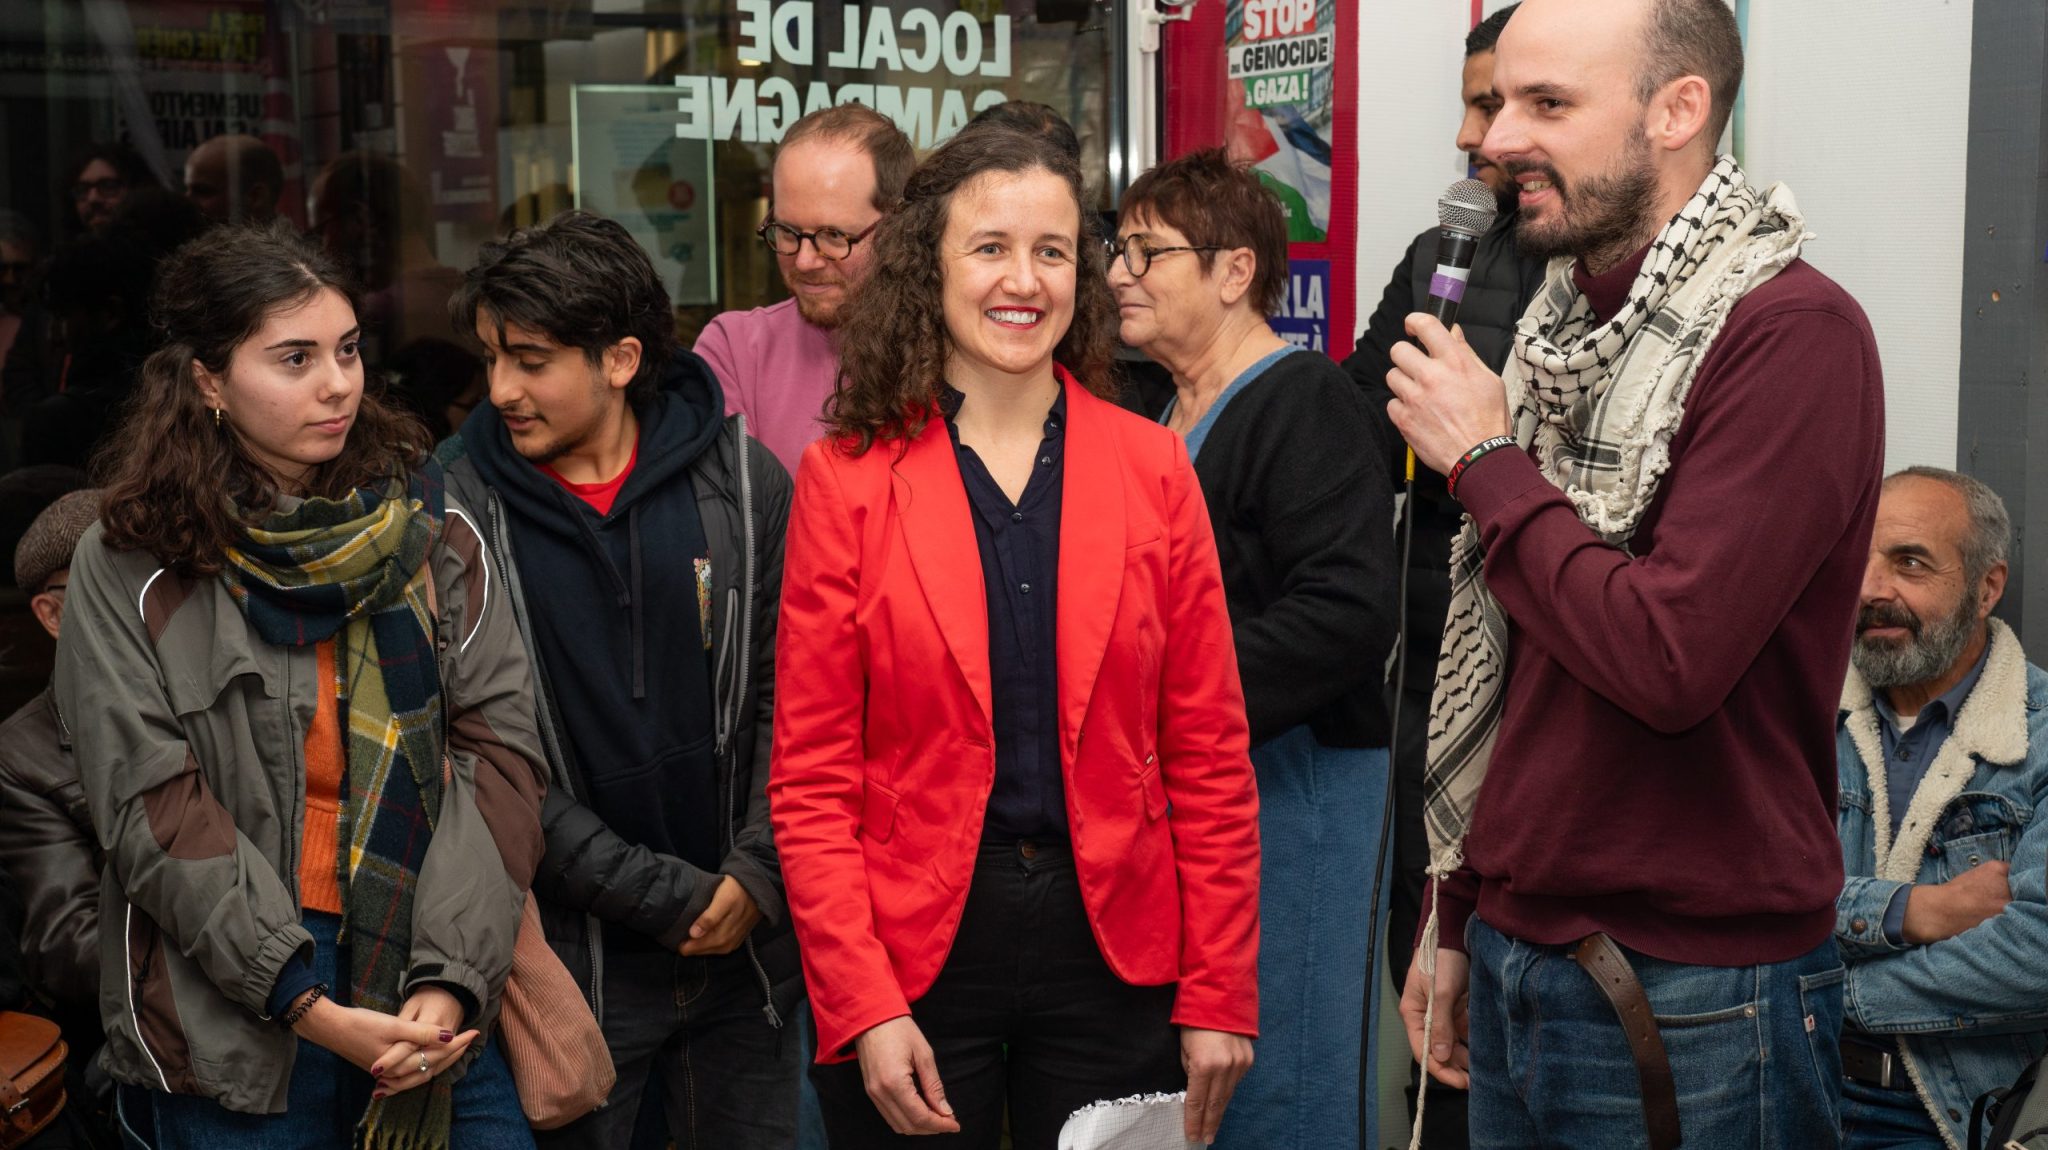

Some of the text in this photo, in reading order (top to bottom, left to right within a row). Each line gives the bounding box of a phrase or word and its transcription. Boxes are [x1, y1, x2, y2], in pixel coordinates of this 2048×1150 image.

[1243, 0, 1316, 40] STOP
[1293, 274, 1325, 319] LA
[1483, 436, 1515, 450] FREE
